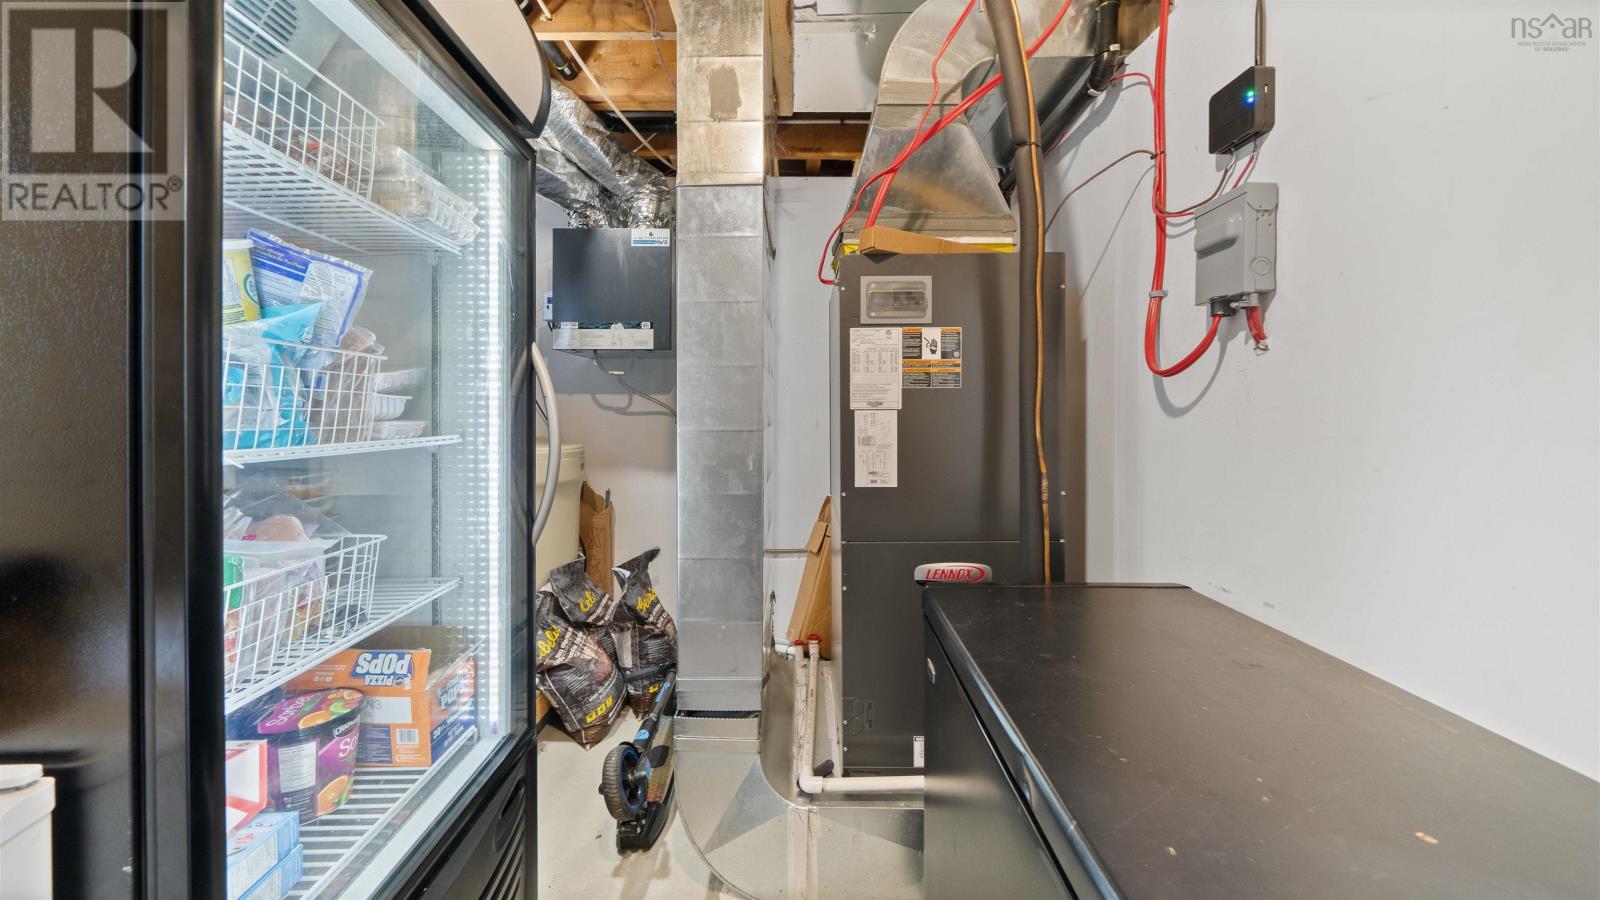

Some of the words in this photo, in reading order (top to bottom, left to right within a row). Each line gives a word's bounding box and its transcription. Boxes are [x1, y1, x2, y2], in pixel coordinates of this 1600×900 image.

[925, 567, 974, 580] LENNOX
[356, 652, 412, 674] POPS
[364, 674, 394, 686] PIZZA
